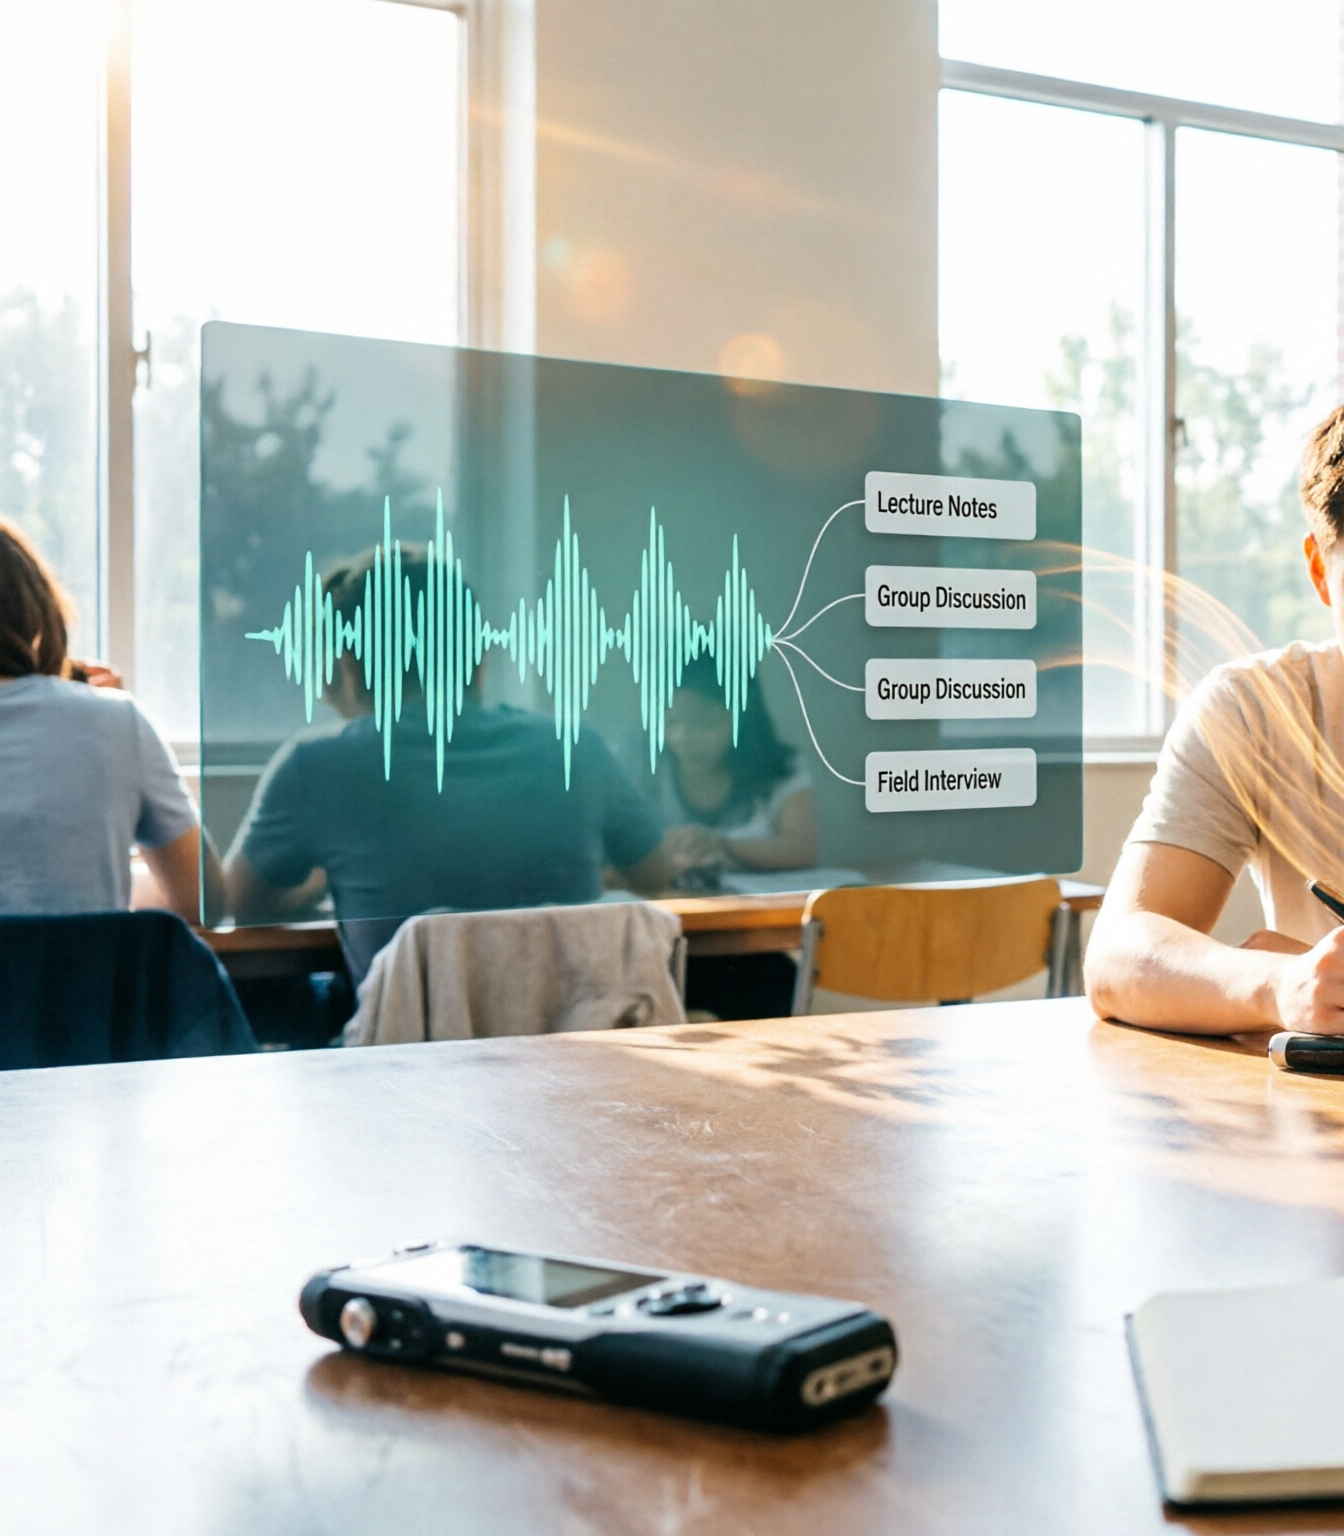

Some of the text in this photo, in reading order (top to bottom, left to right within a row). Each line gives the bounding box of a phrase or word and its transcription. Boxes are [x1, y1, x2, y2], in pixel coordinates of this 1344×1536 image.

[877, 490, 998, 519] Lecture Notes
[877, 584, 1026, 613] Group Discussion
[877, 677, 1026, 705] Group Discussion
[877, 767, 1002, 793] Field Interview
